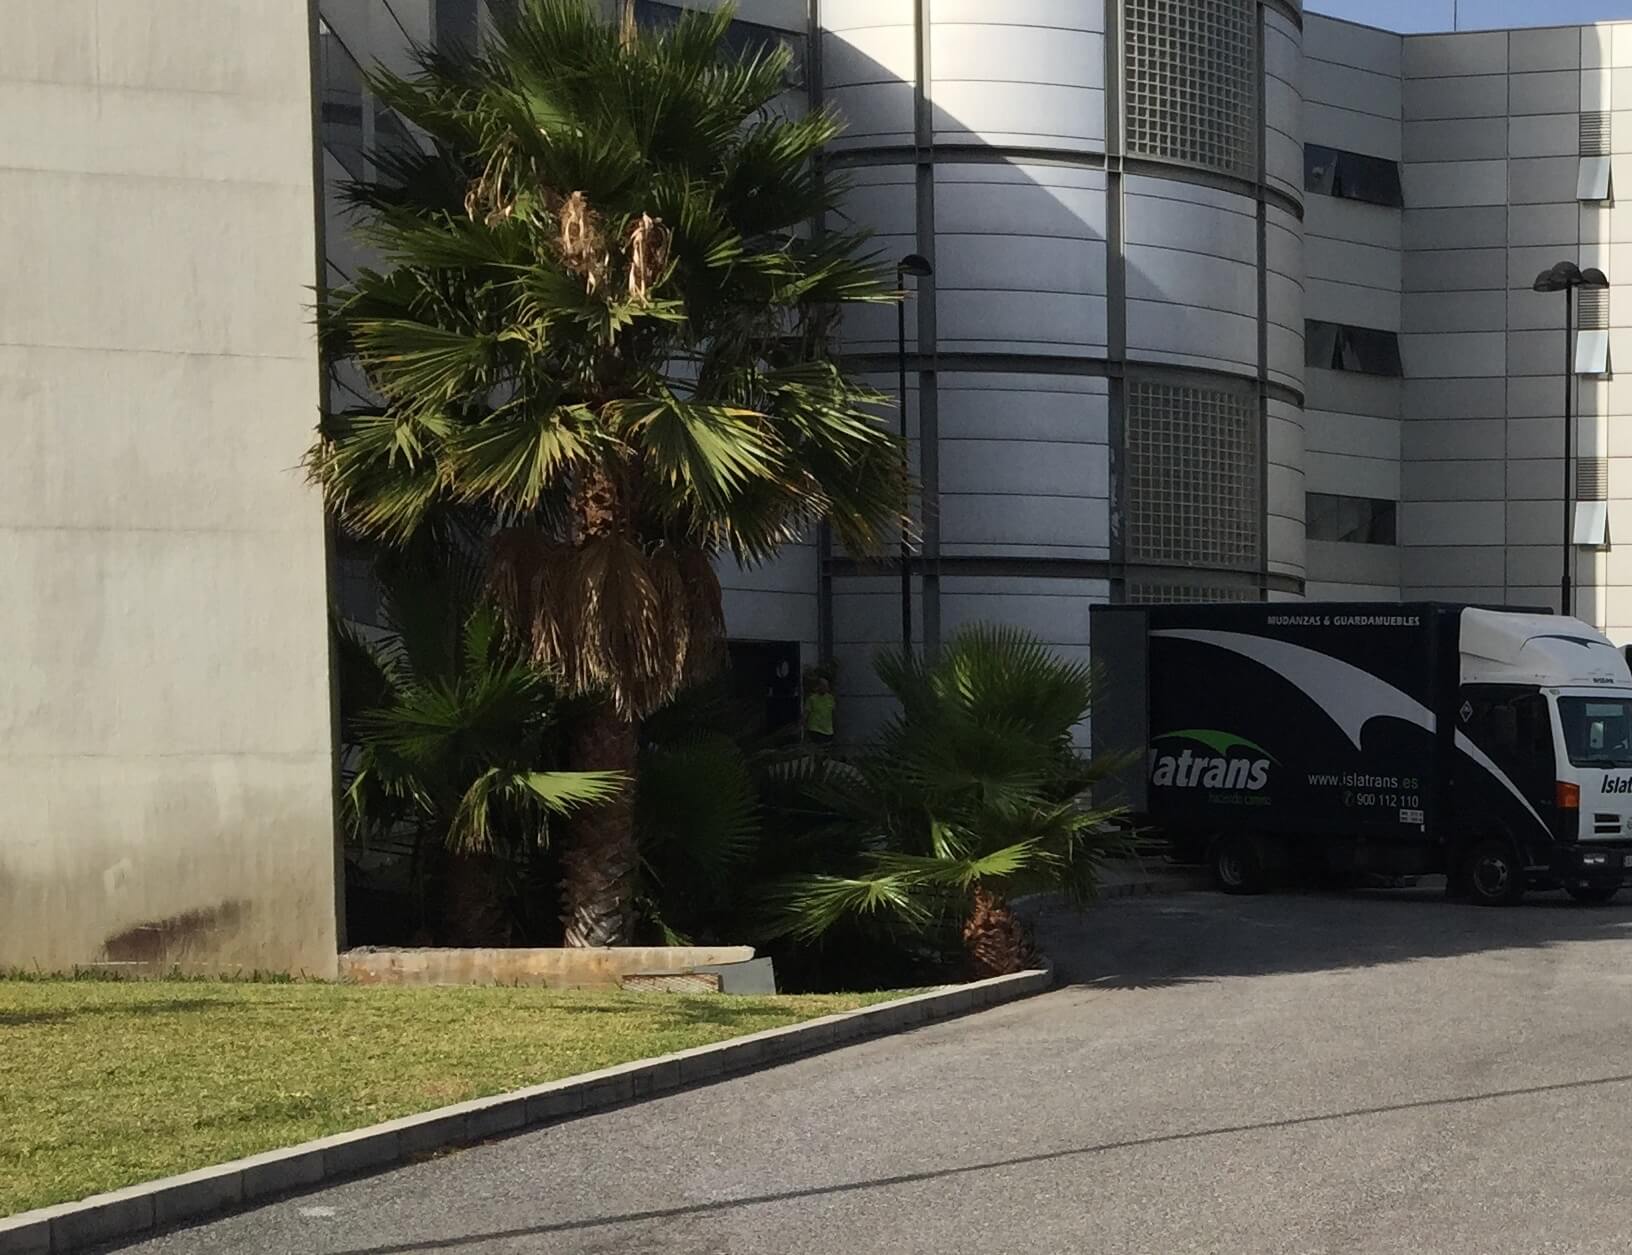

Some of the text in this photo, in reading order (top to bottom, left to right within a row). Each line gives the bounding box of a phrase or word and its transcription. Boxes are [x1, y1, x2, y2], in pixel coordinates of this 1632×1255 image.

[1267, 615, 1420, 627] MUDANZAS & GUARDAMUEBLES
[1151, 748, 1271, 791] atrans
[1356, 793, 1419, 808] 900 112 110
